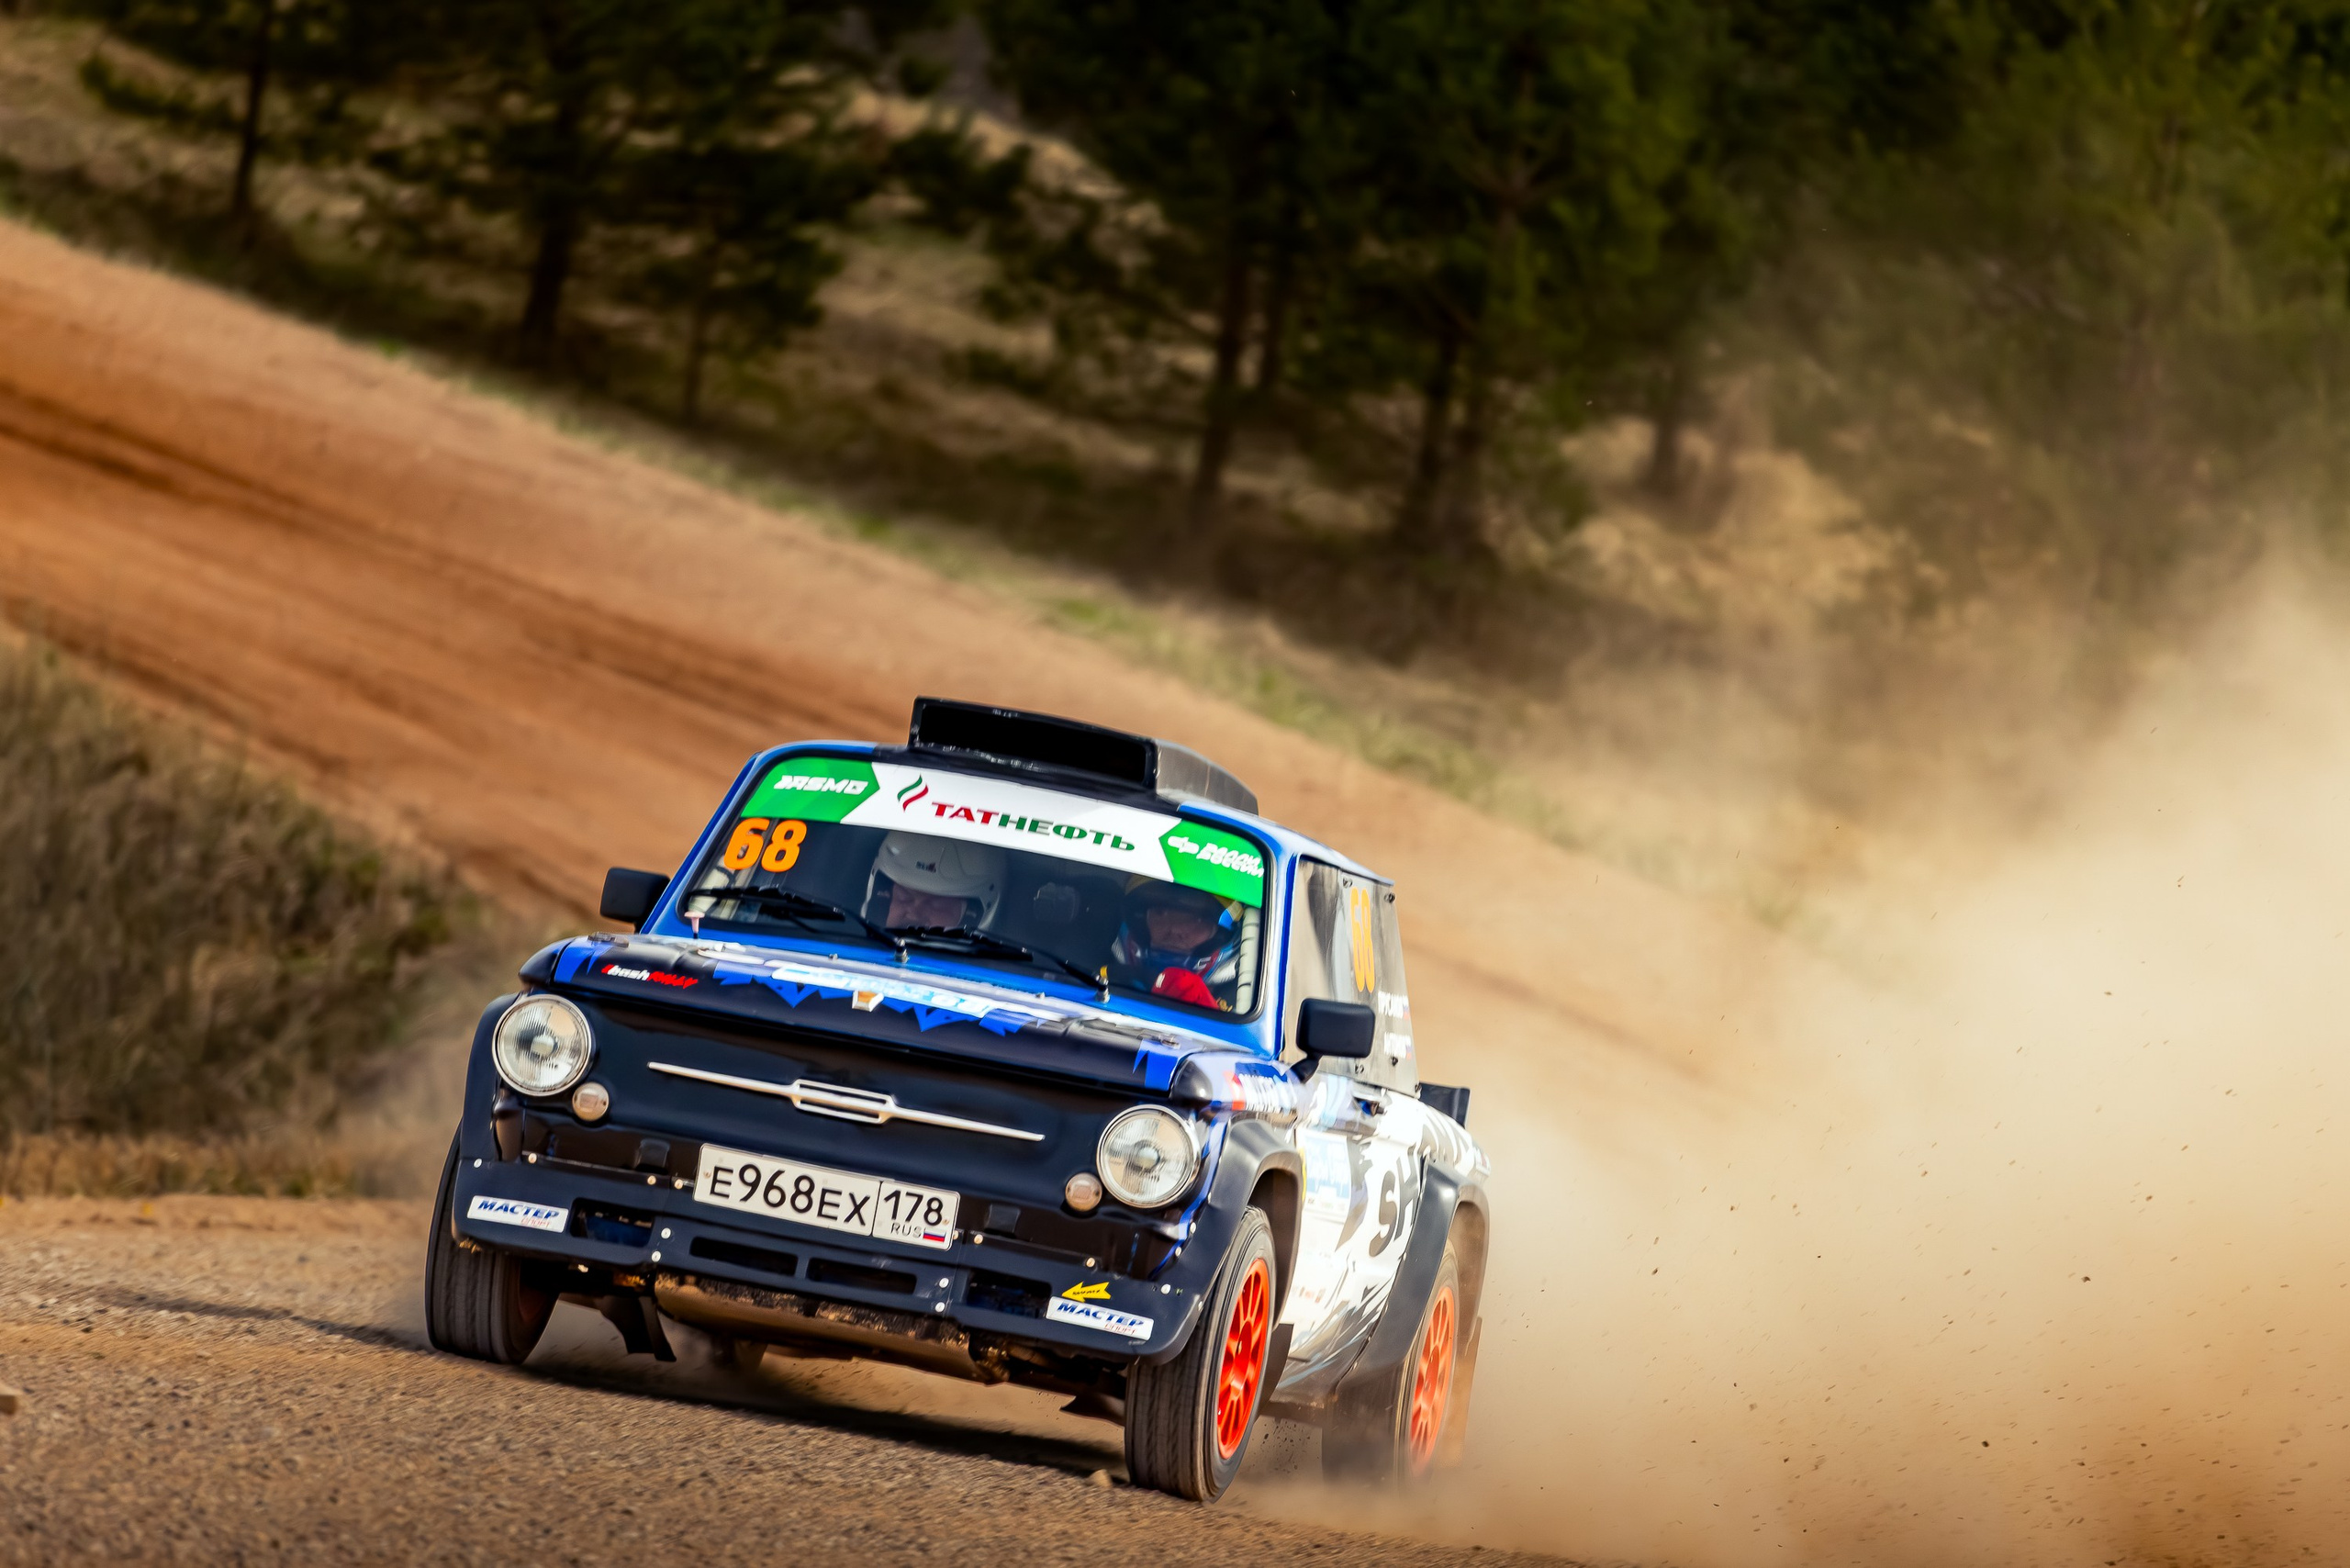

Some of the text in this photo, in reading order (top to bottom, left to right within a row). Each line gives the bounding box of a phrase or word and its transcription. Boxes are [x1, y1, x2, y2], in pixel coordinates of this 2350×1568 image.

[723, 816, 808, 873] 68
[932, 801, 1135, 851] ТАТНЕФТЬ
[1350, 886, 1375, 993] 68
[477, 1200, 560, 1219] МАСТЕР
[710, 1164, 944, 1226] Е968ЕХ 178
[890, 1222, 922, 1238] RUS
[1058, 1302, 1145, 1327] МАСТЕР
